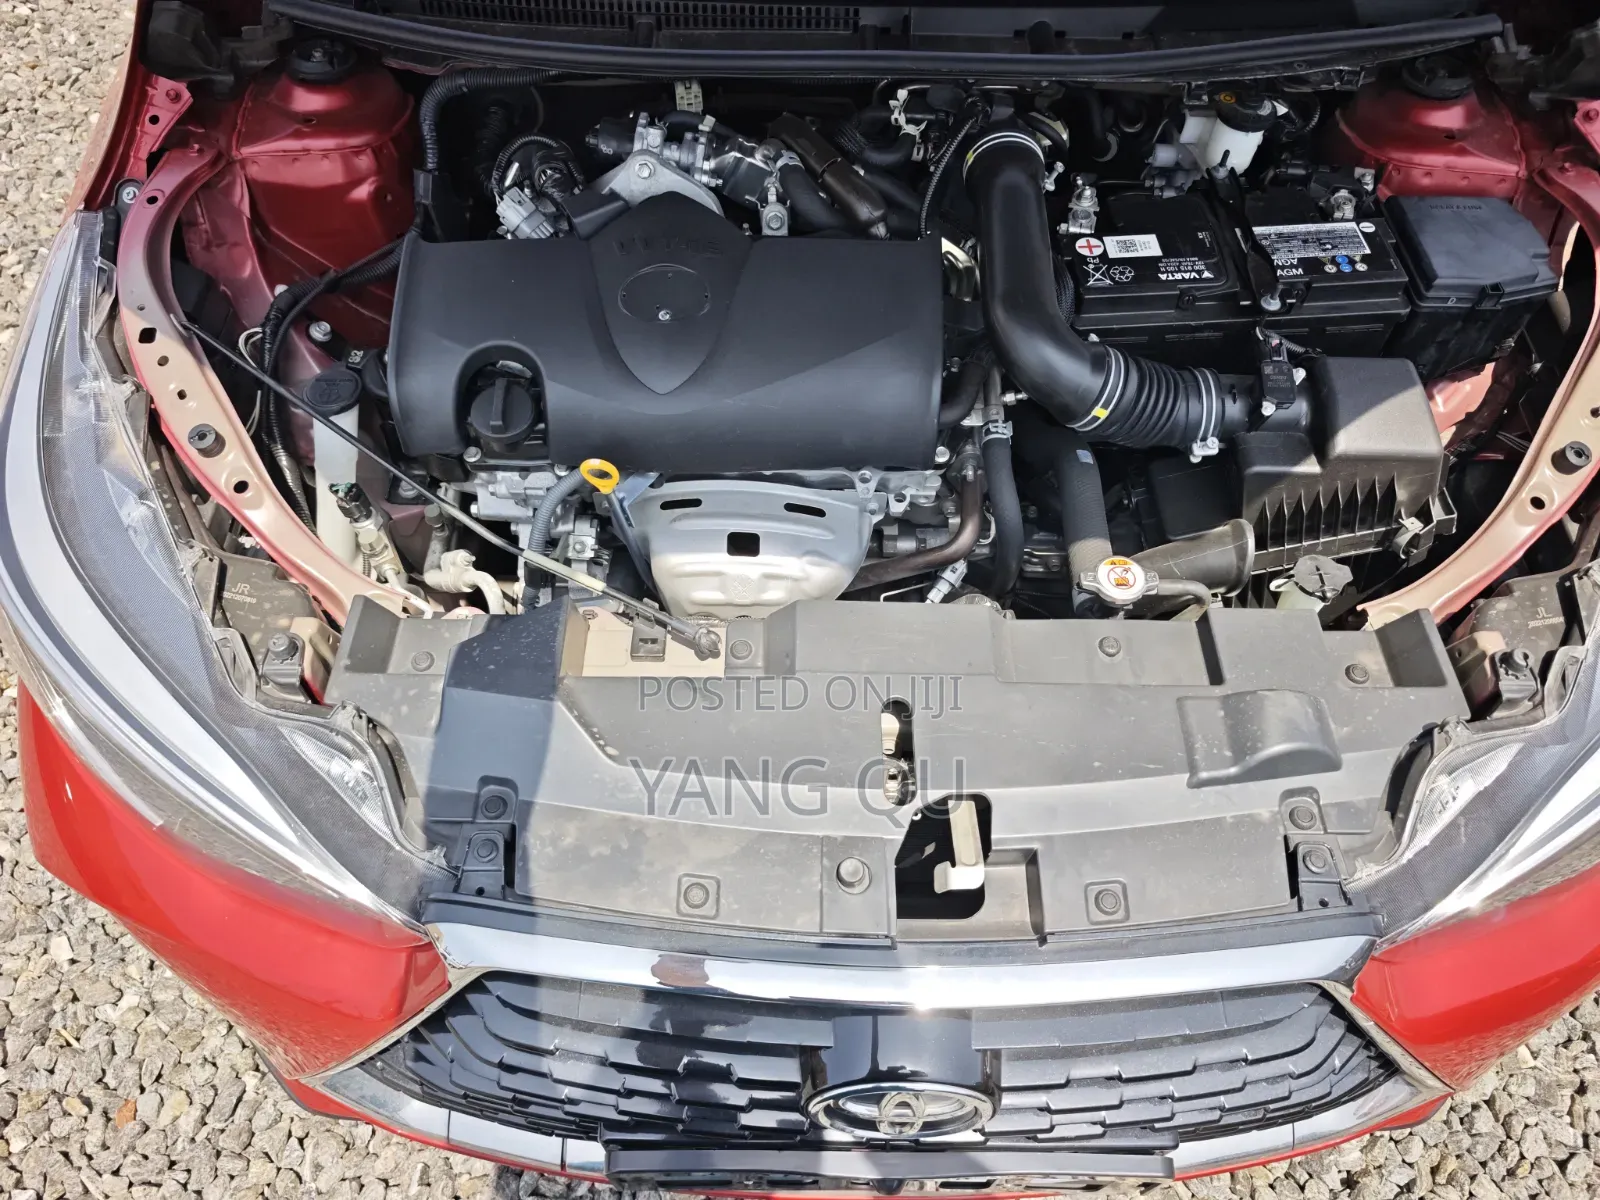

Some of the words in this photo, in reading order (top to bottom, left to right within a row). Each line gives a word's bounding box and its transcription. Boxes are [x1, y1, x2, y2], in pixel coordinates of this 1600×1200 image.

[1158, 272, 1200, 281] VARTA
[1276, 268, 1304, 276] AGM
[231, 582, 250, 595] JR
